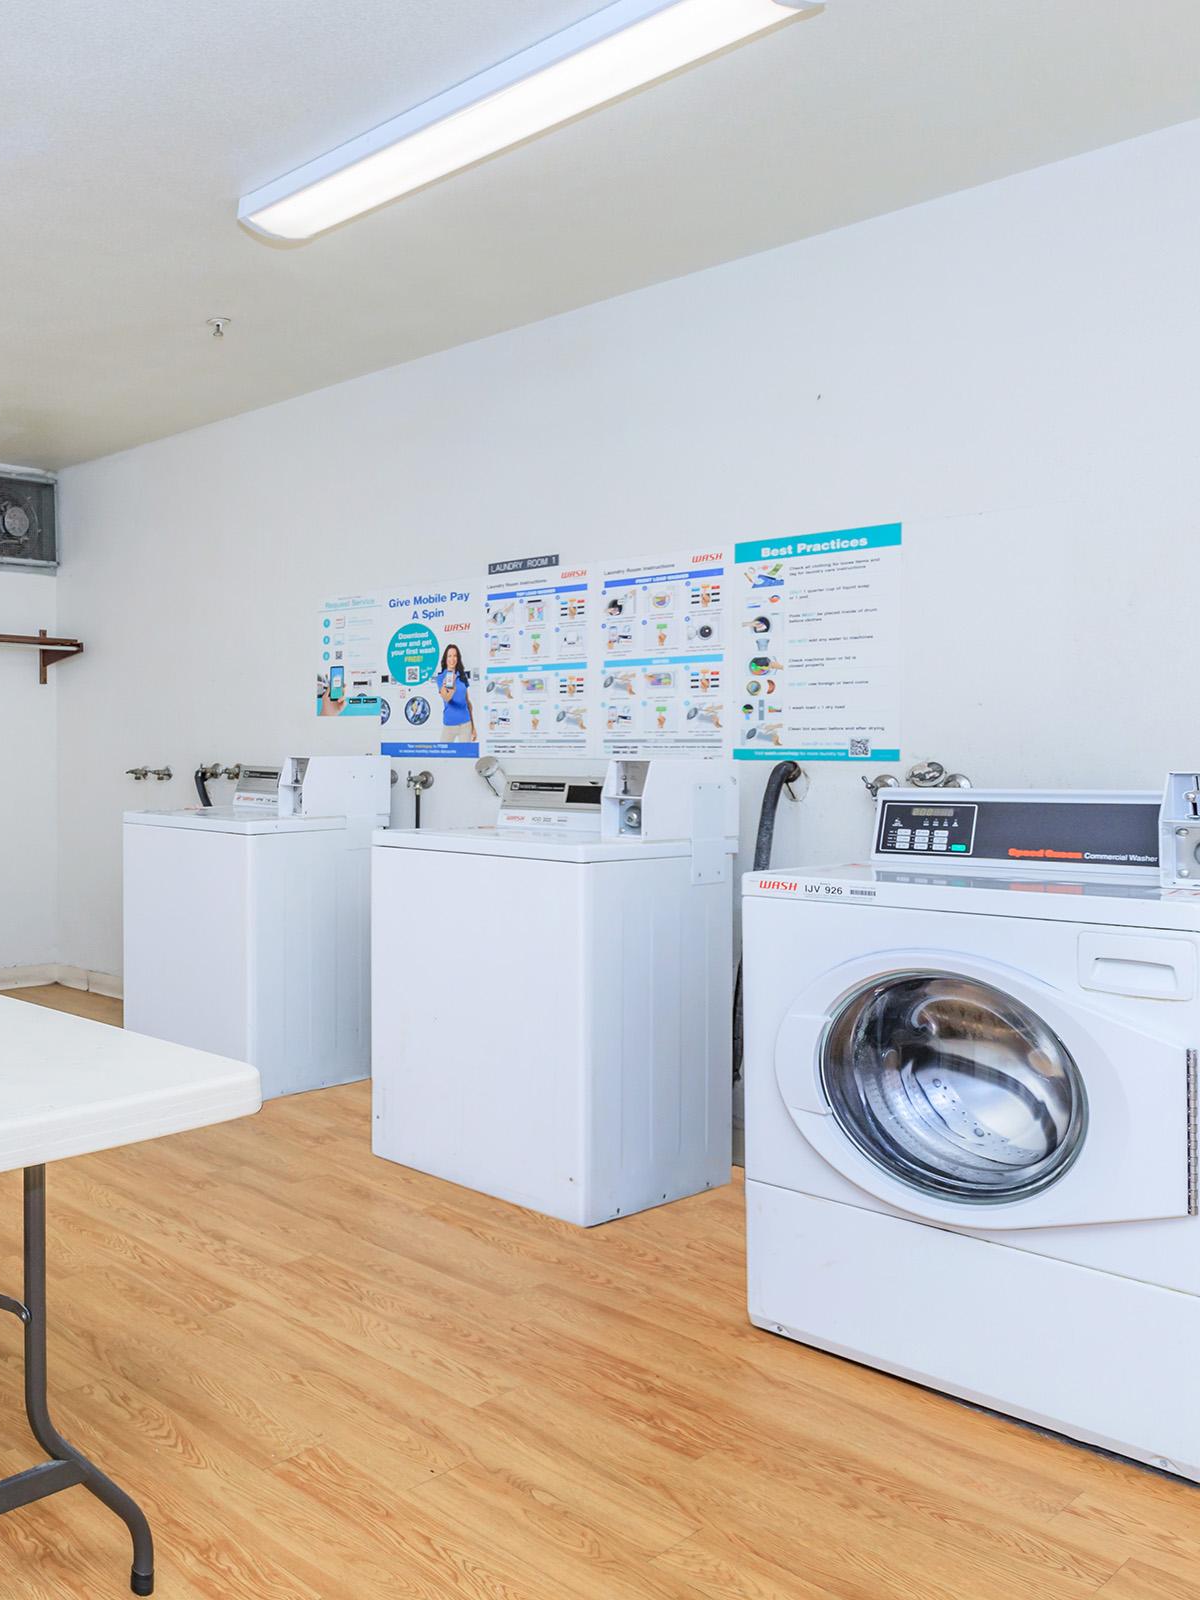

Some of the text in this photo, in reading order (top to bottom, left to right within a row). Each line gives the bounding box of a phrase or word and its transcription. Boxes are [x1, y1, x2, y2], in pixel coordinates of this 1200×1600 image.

[761, 537, 868, 558] Best Practices
[691, 552, 723, 563] WASH
[490, 561, 523, 573] LAUNDRY
[527, 557, 548, 567] ROOM
[643, 563, 675, 571] Instructions
[561, 570, 587, 578] WASH
[389, 592, 470, 608] Give Mobile Pay
[412, 608, 445, 620] A Spin
[444, 623, 471, 632] WASH
[398, 631, 429, 640] Download
[422, 640, 432, 648] get
[391, 650, 405, 658] your
[1084, 852, 1128, 861] Commercial
[1129, 854, 1158, 862] Washer
[759, 880, 843, 895] WASH IJV 926
